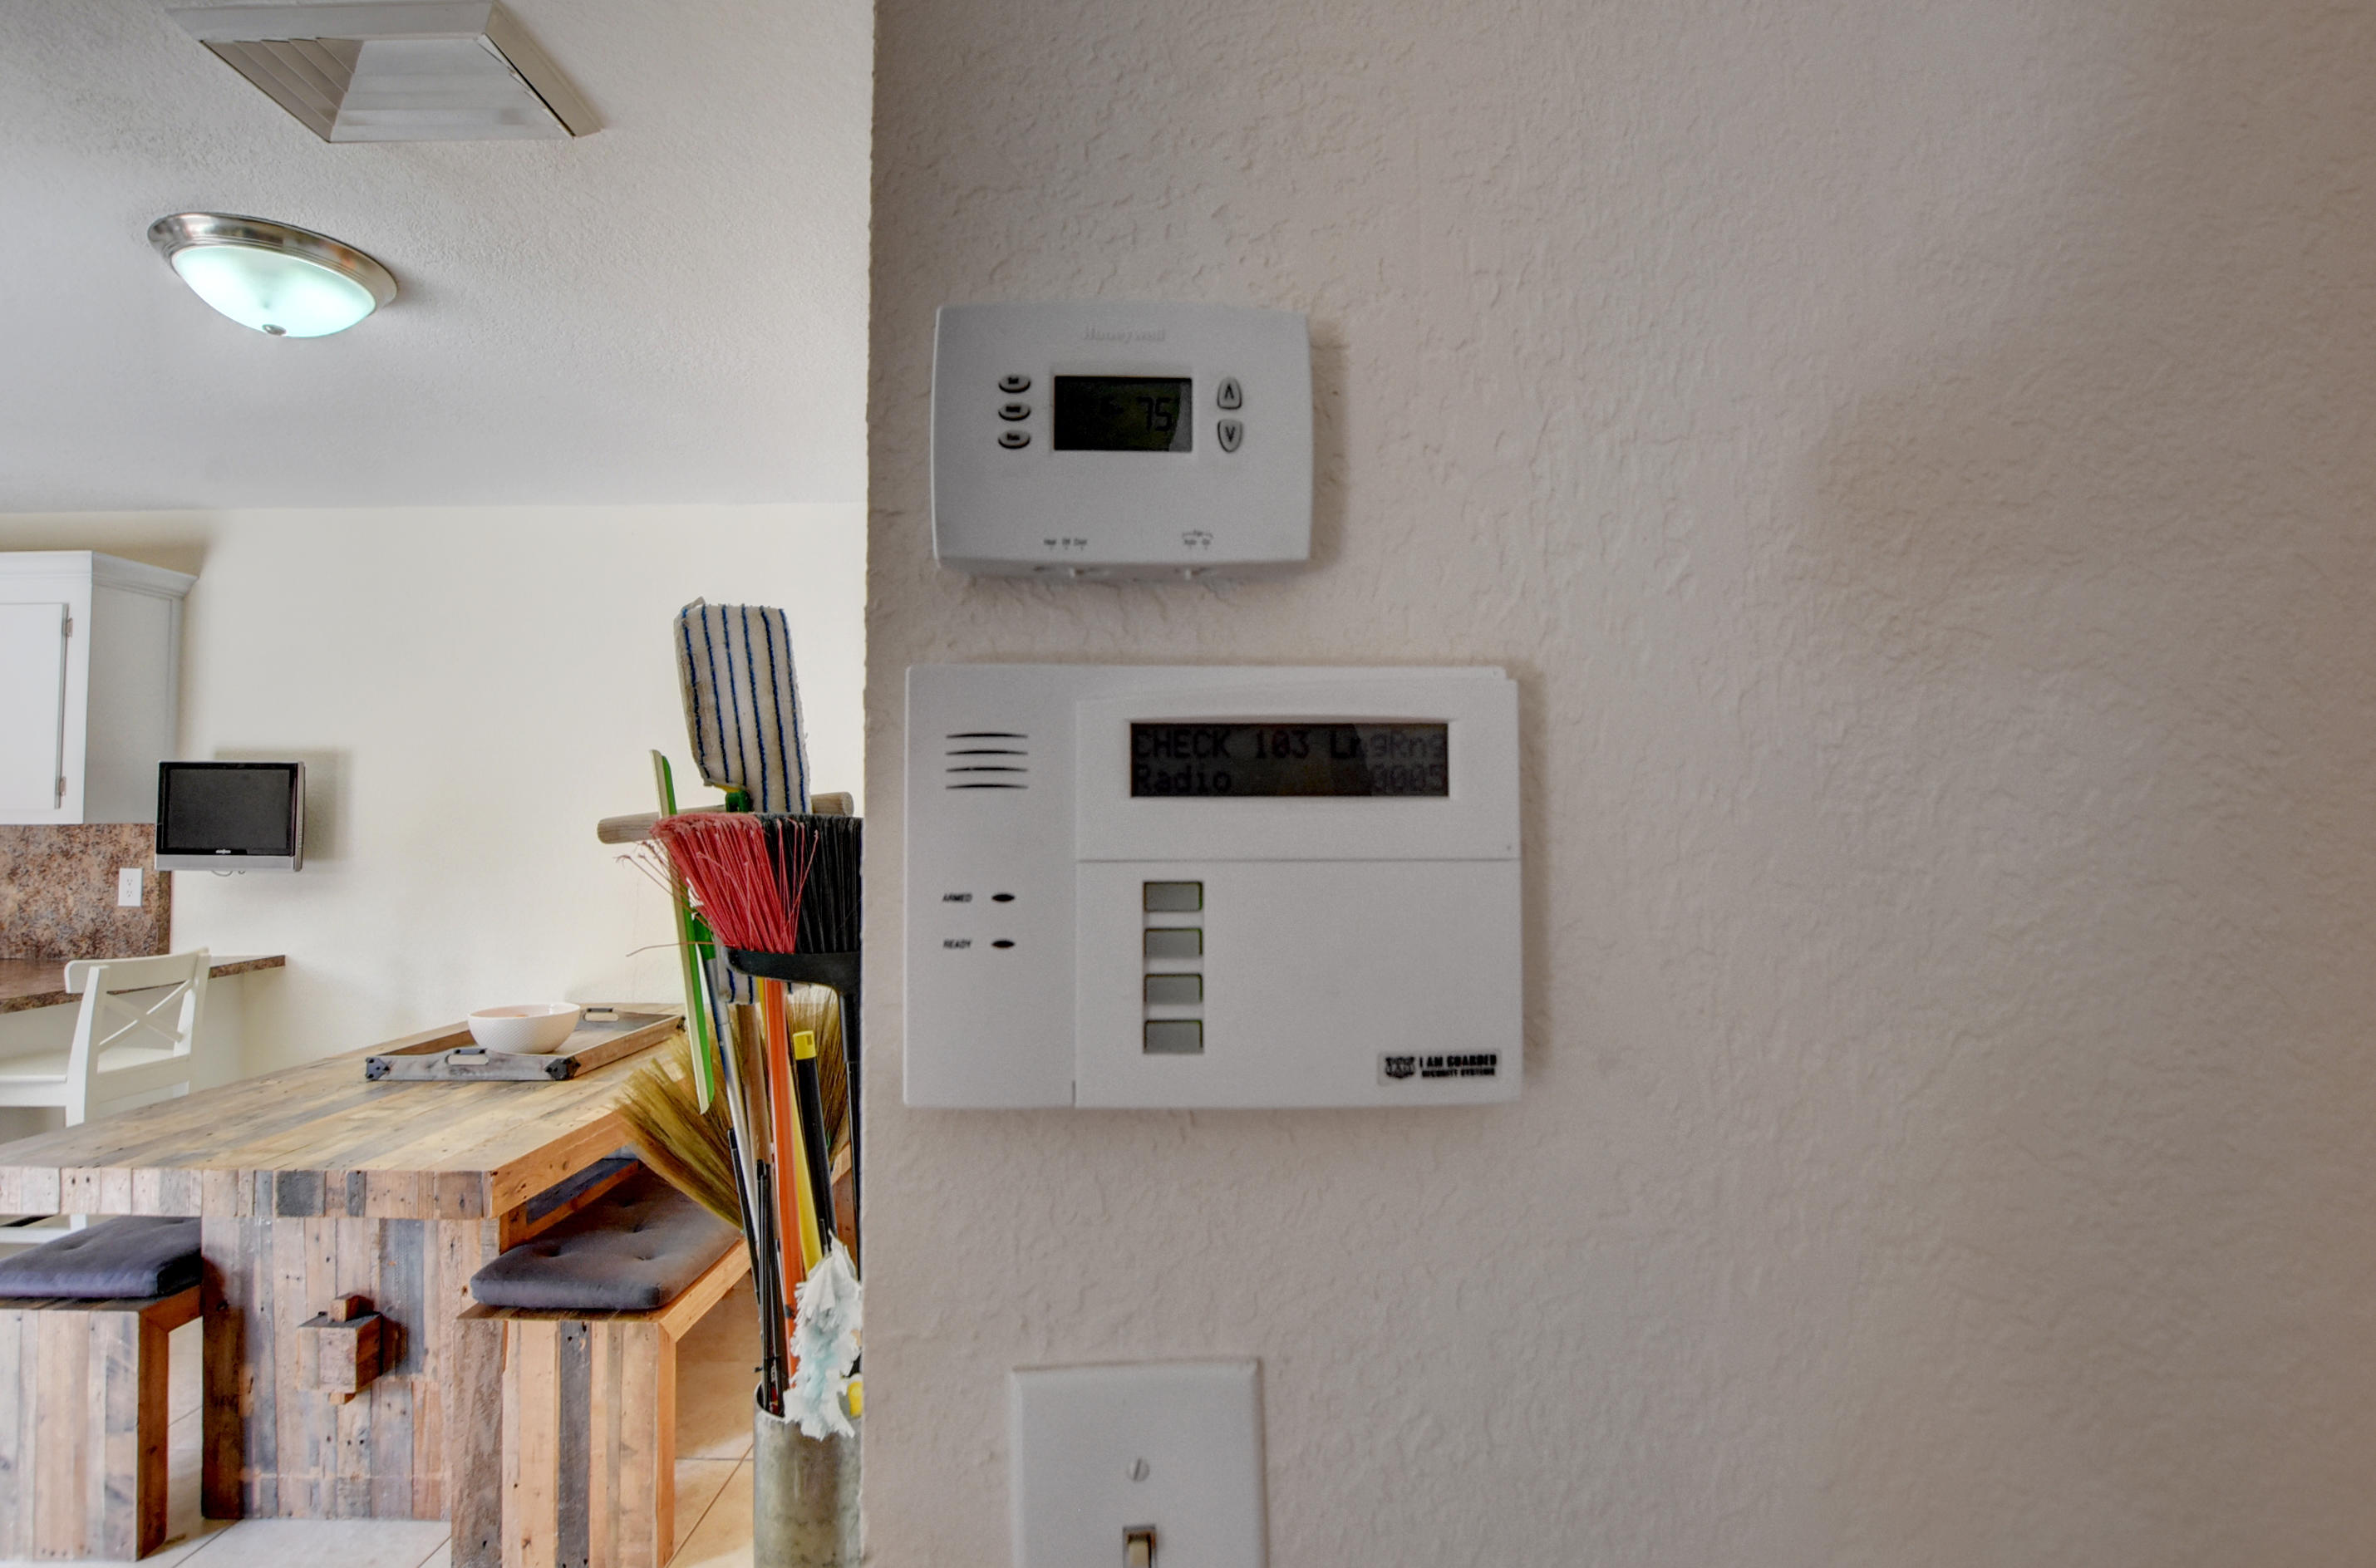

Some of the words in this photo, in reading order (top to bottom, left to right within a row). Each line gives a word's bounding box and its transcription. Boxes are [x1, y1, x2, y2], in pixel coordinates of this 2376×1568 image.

[1084, 327, 1165, 343] Honeywell
[1135, 396, 1173, 432] 75
[1134, 729, 1232, 760] CHECK
[1253, 729, 1311, 760] 103
[1134, 764, 1232, 794] Radio
